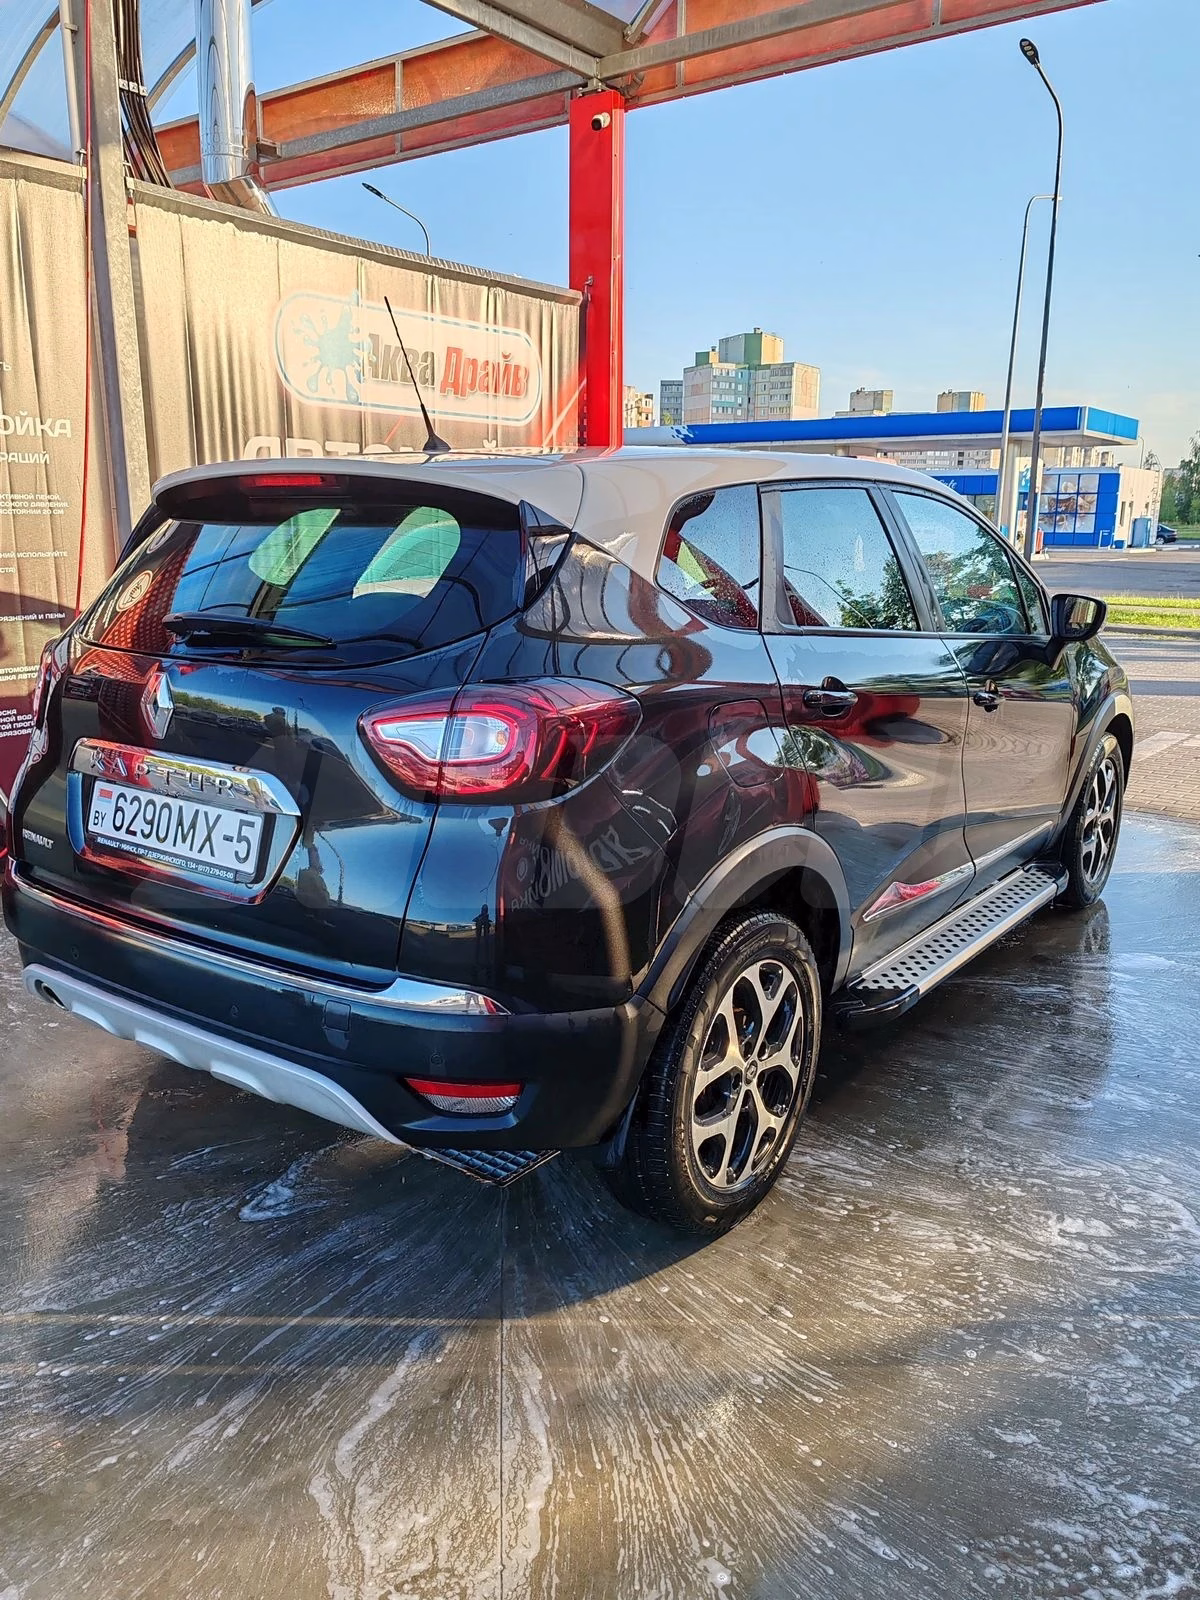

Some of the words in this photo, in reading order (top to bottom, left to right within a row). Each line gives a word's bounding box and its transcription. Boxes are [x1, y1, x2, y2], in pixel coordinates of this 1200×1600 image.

[440, 346, 530, 399] Драйв
[90, 747, 237, 799] KAPTUR
[92, 810, 106, 828] BY
[22, 828, 55, 849] RENAULT
